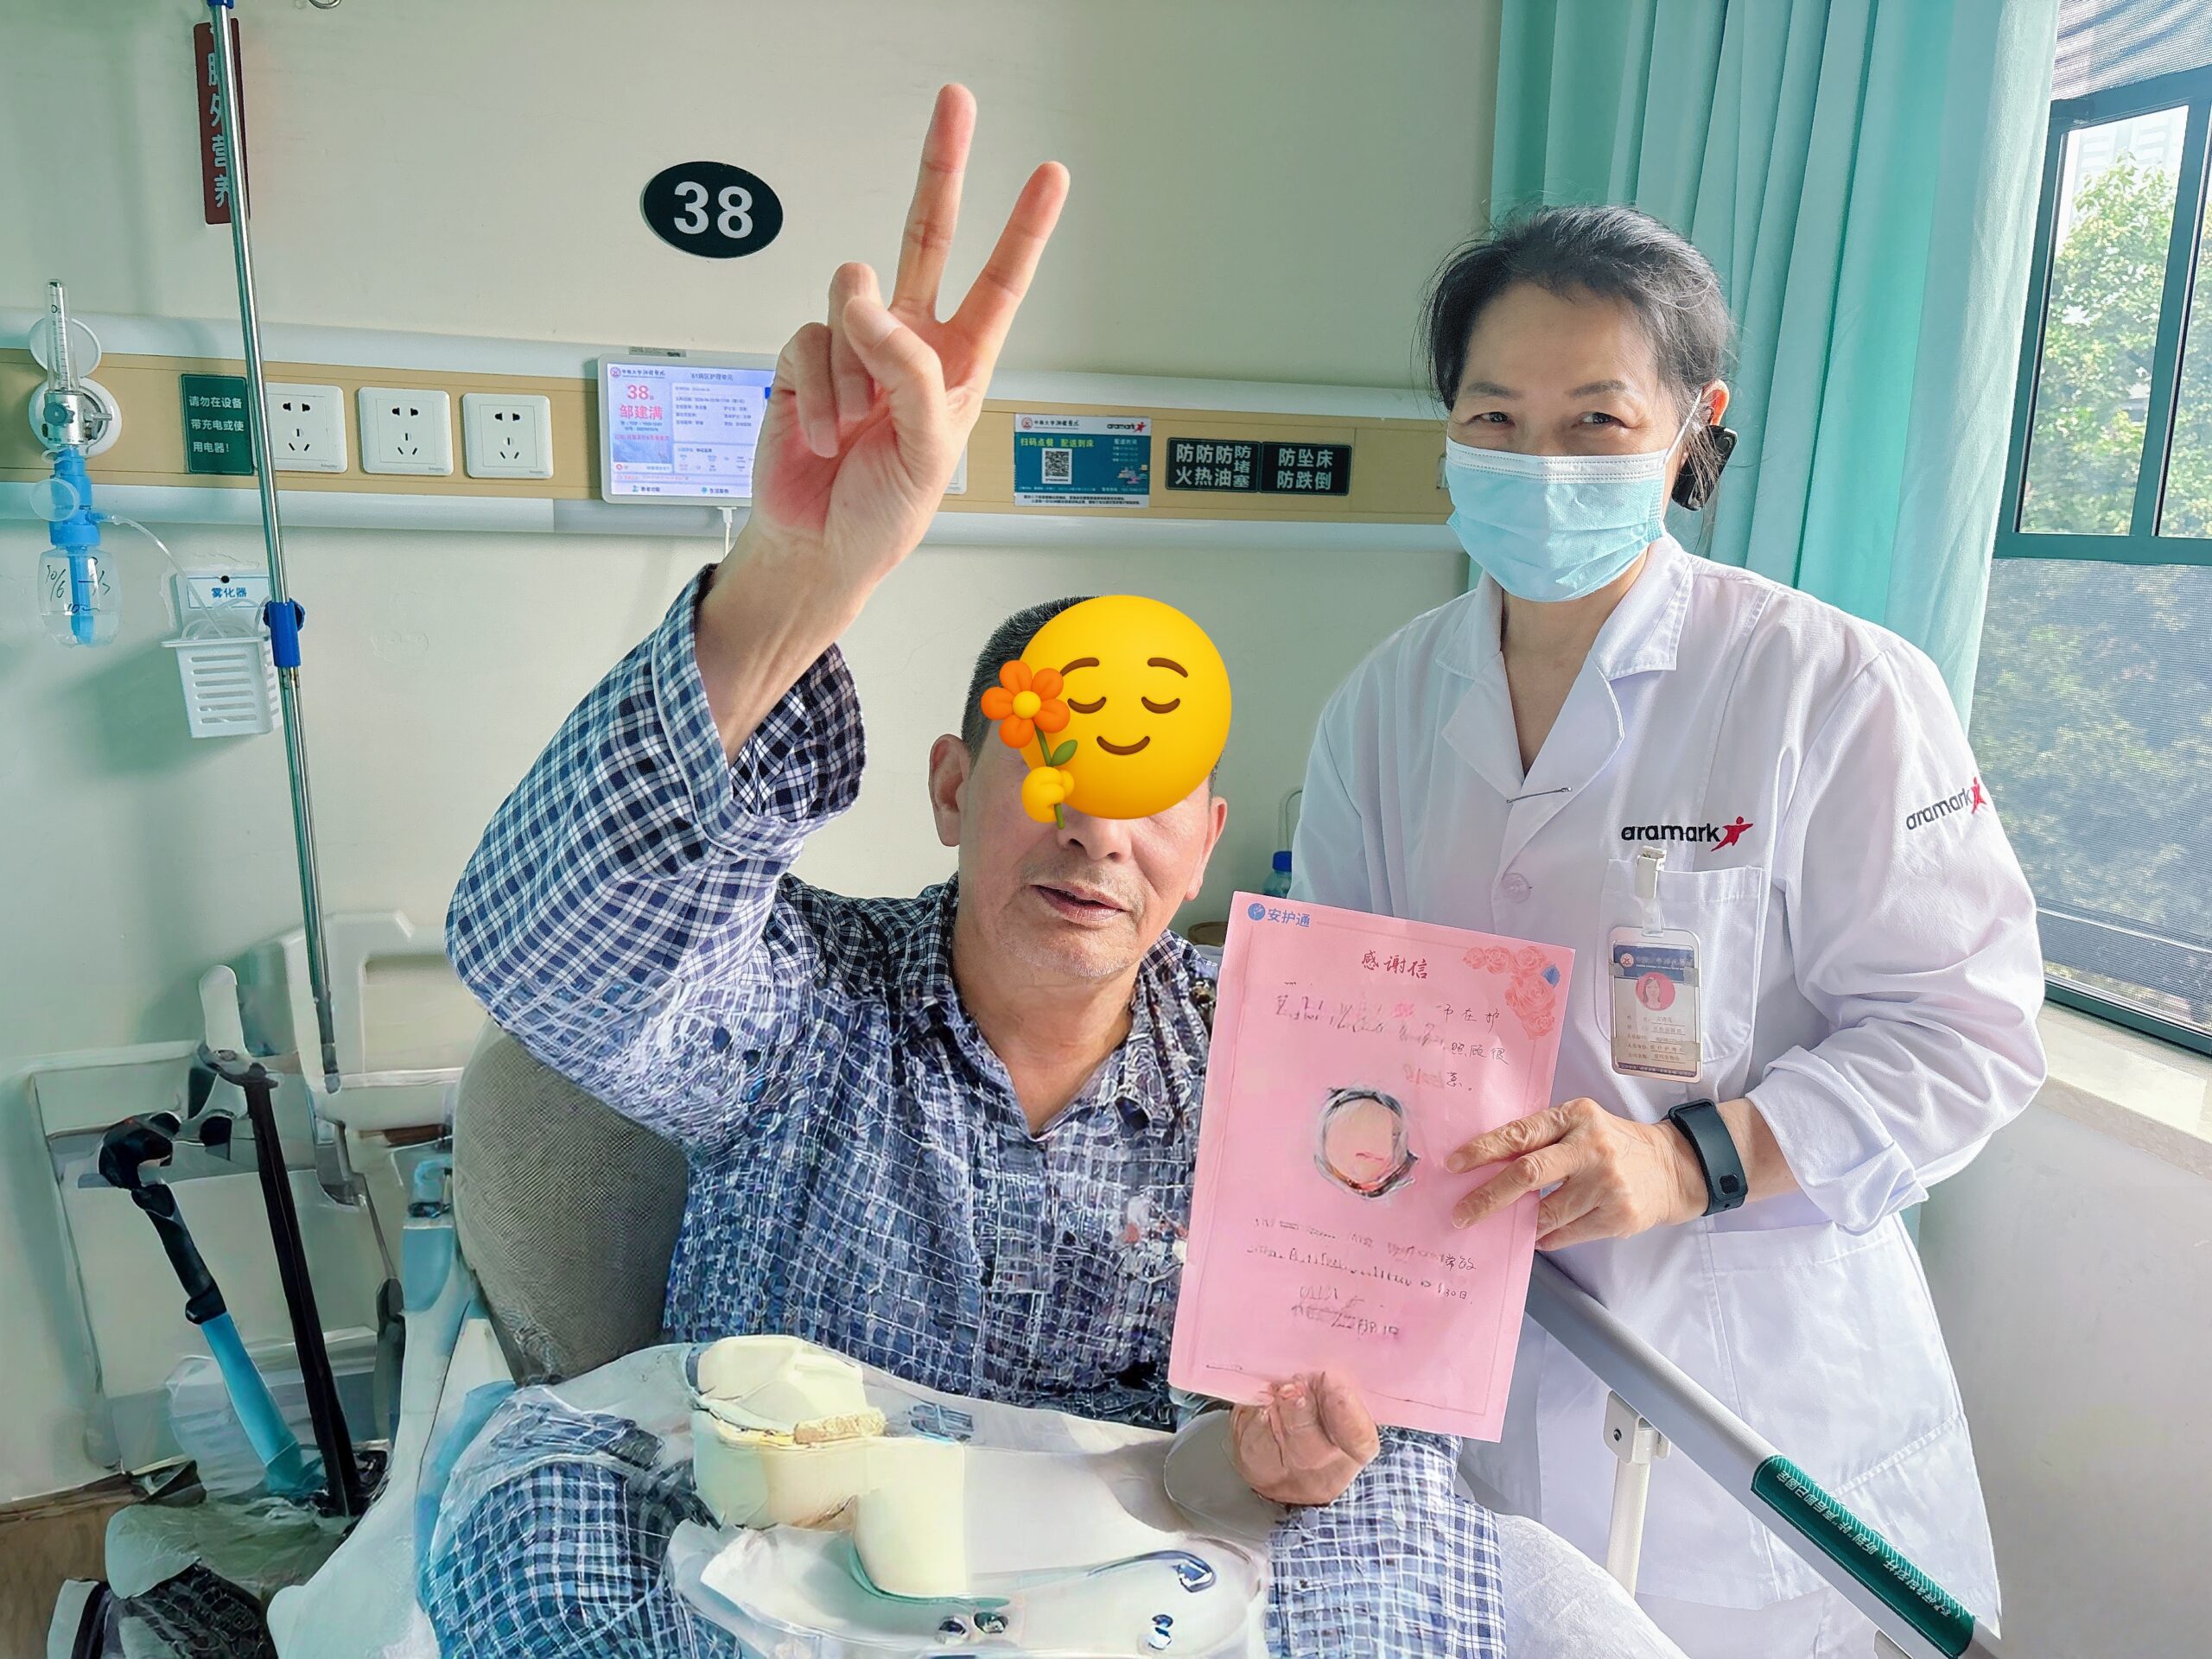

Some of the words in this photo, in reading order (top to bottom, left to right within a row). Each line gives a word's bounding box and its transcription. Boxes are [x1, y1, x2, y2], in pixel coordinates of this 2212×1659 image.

[674, 181, 753, 239] 38
[188, 395, 242, 409] 请勿在设备
[191, 418, 245, 432] 带充电或使
[1278, 448, 1334, 468] 防坠床
[1276, 470, 1332, 491] 防跌倒
[211, 587, 247, 599] 雾化器
[1906, 787, 1974, 831] aramark
[1621, 823, 1721, 844] aramark
[1267, 907, 1311, 929] 安护通
[1361, 950, 1428, 980] 感谢信
